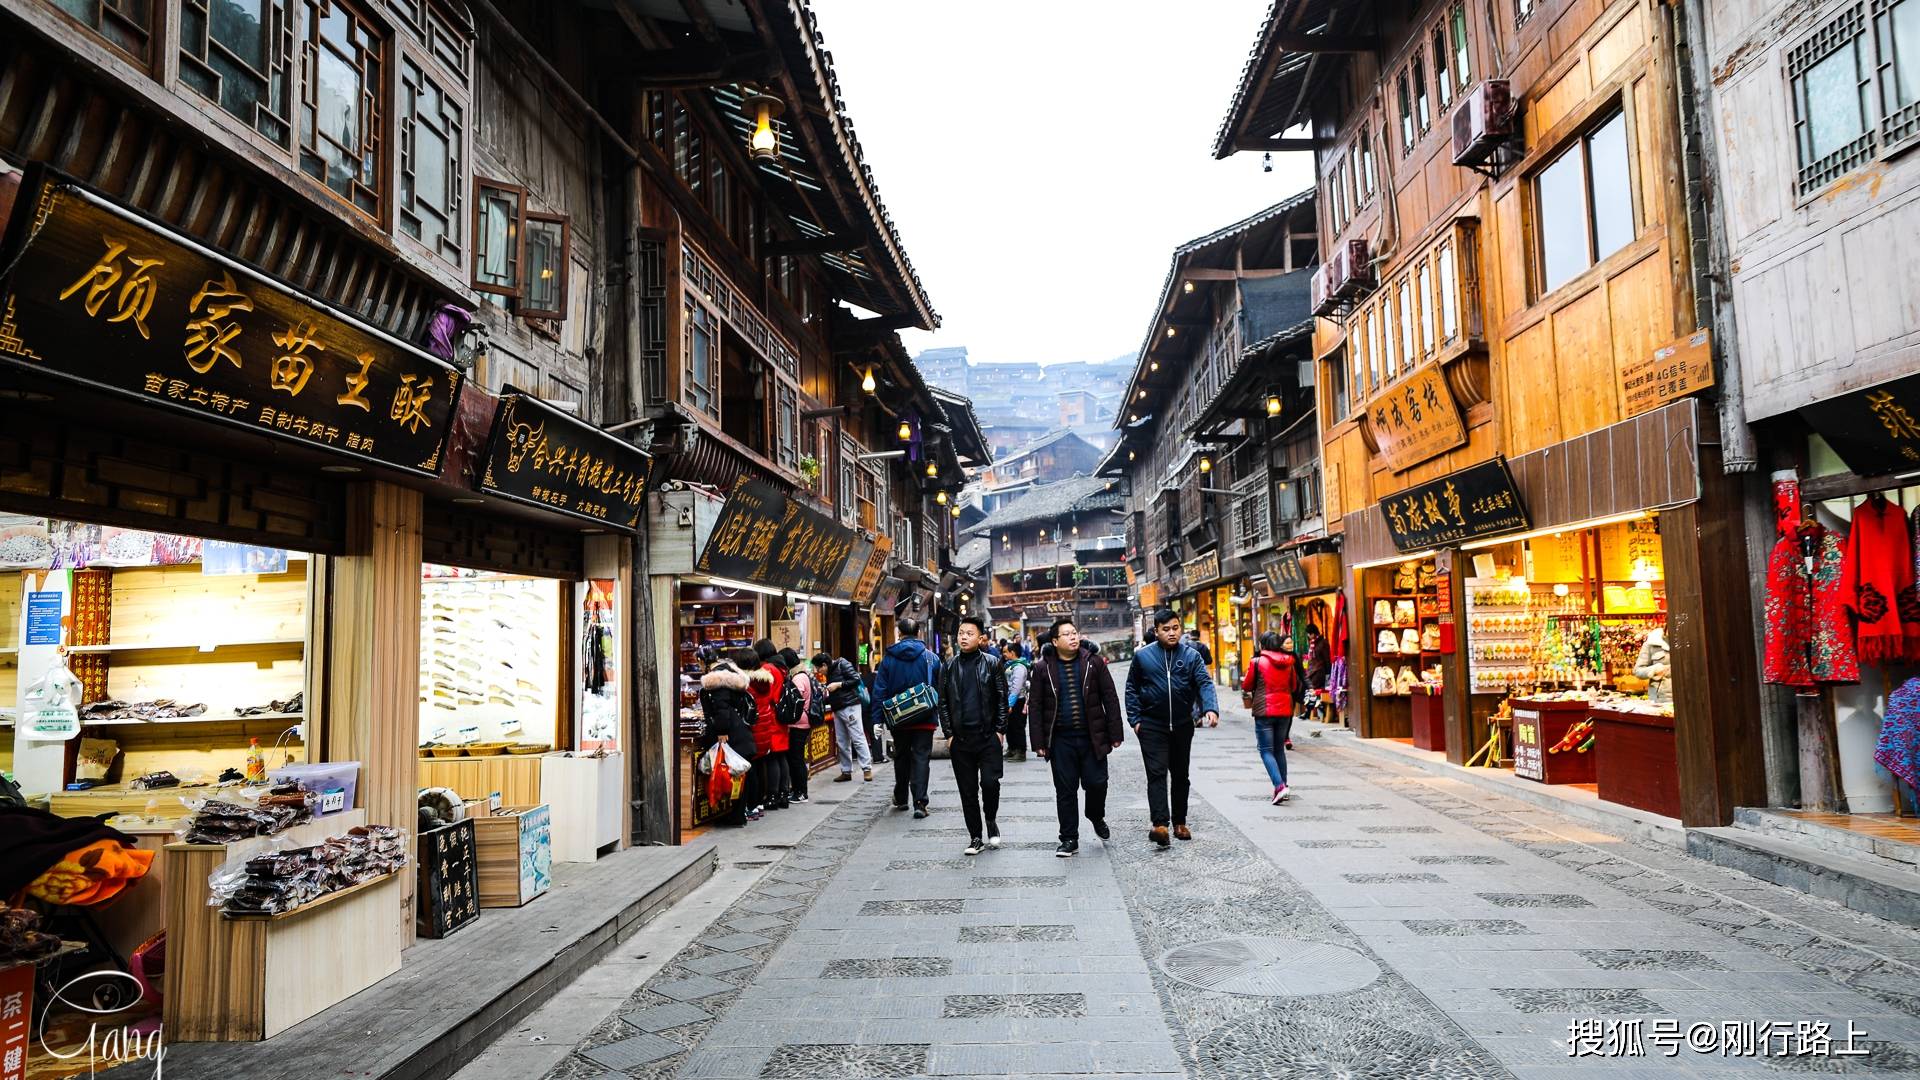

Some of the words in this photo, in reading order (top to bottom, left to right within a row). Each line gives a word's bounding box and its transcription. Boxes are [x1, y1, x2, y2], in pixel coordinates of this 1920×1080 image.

[60, 234, 435, 435] 顾家苗王酥
[1656, 361, 1687, 381] 4G信号
[1659, 377, 1687, 398] 已覆盖
[144, 371, 250, 415] 苗家土特产
[258, 405, 339, 444] 自制牛肉干
[346, 432, 374, 452] 腊肉
[1472, 490, 1512, 514] 工艺品超市
